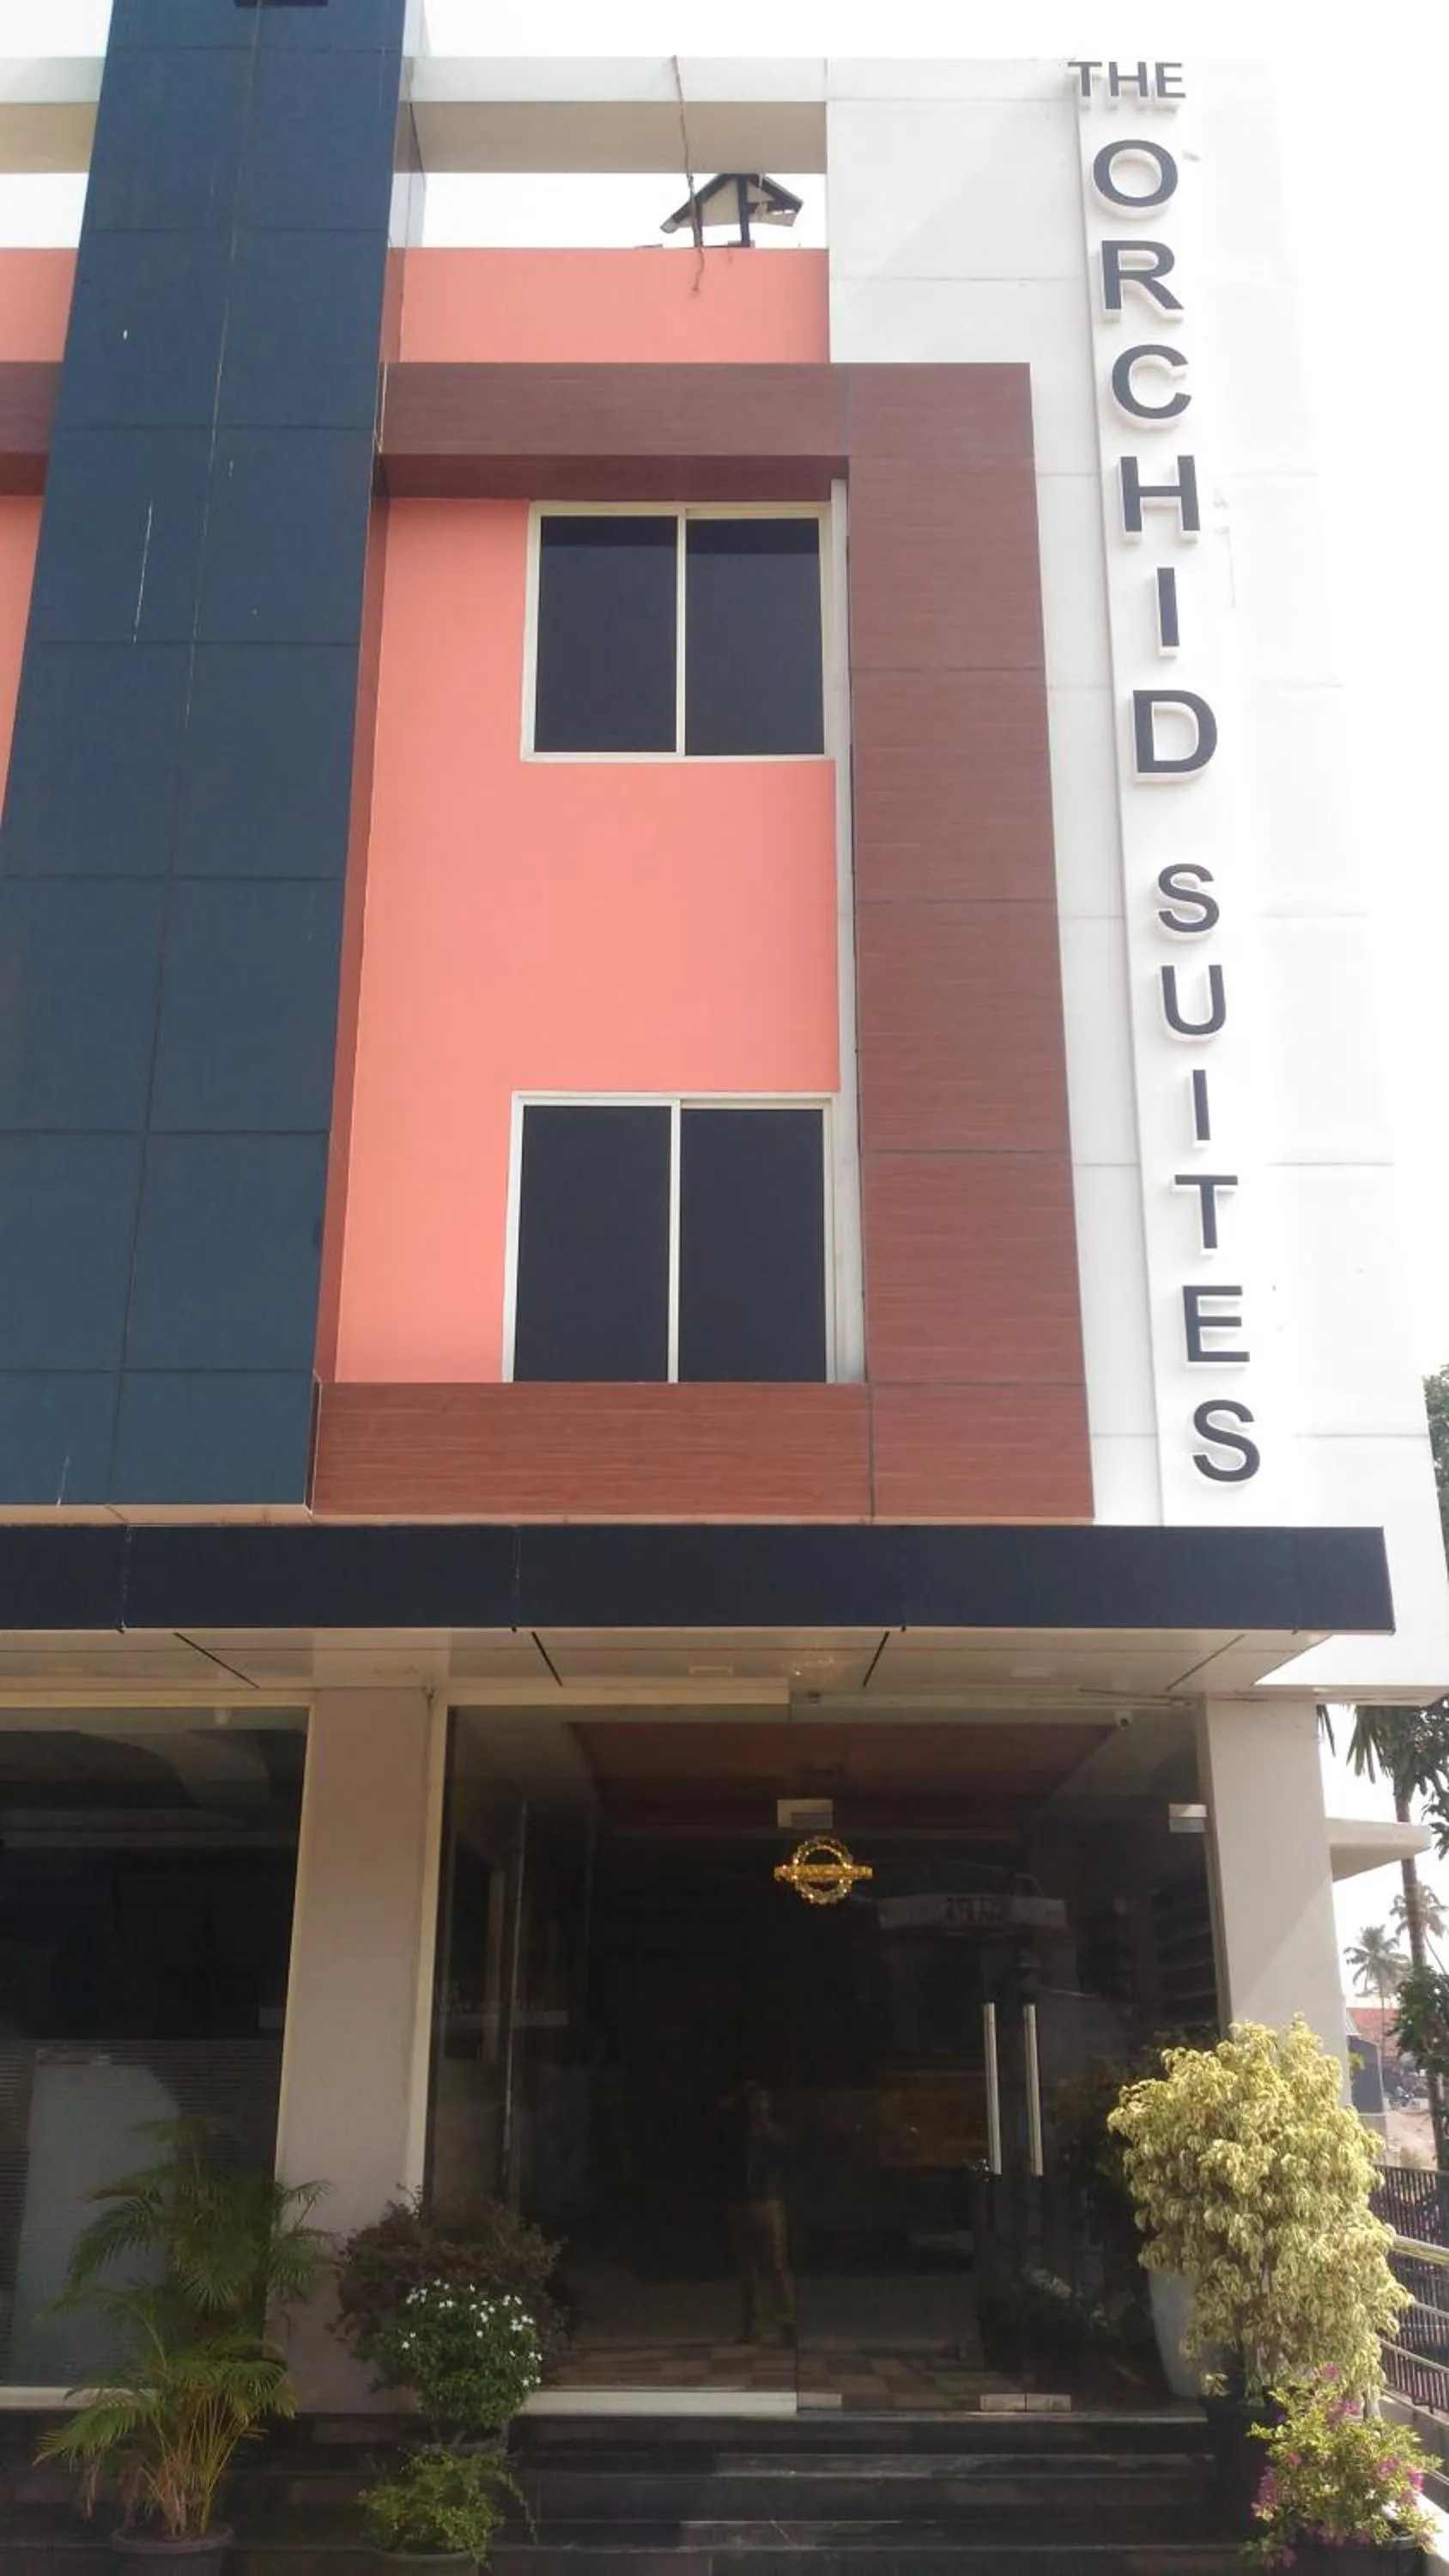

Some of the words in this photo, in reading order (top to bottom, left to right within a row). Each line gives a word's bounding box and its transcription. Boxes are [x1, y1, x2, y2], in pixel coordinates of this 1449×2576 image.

[1068, 61, 1185, 98] THE
[1093, 140, 1218, 774] ORCHID
[1157, 863, 1260, 1483] SUITES
